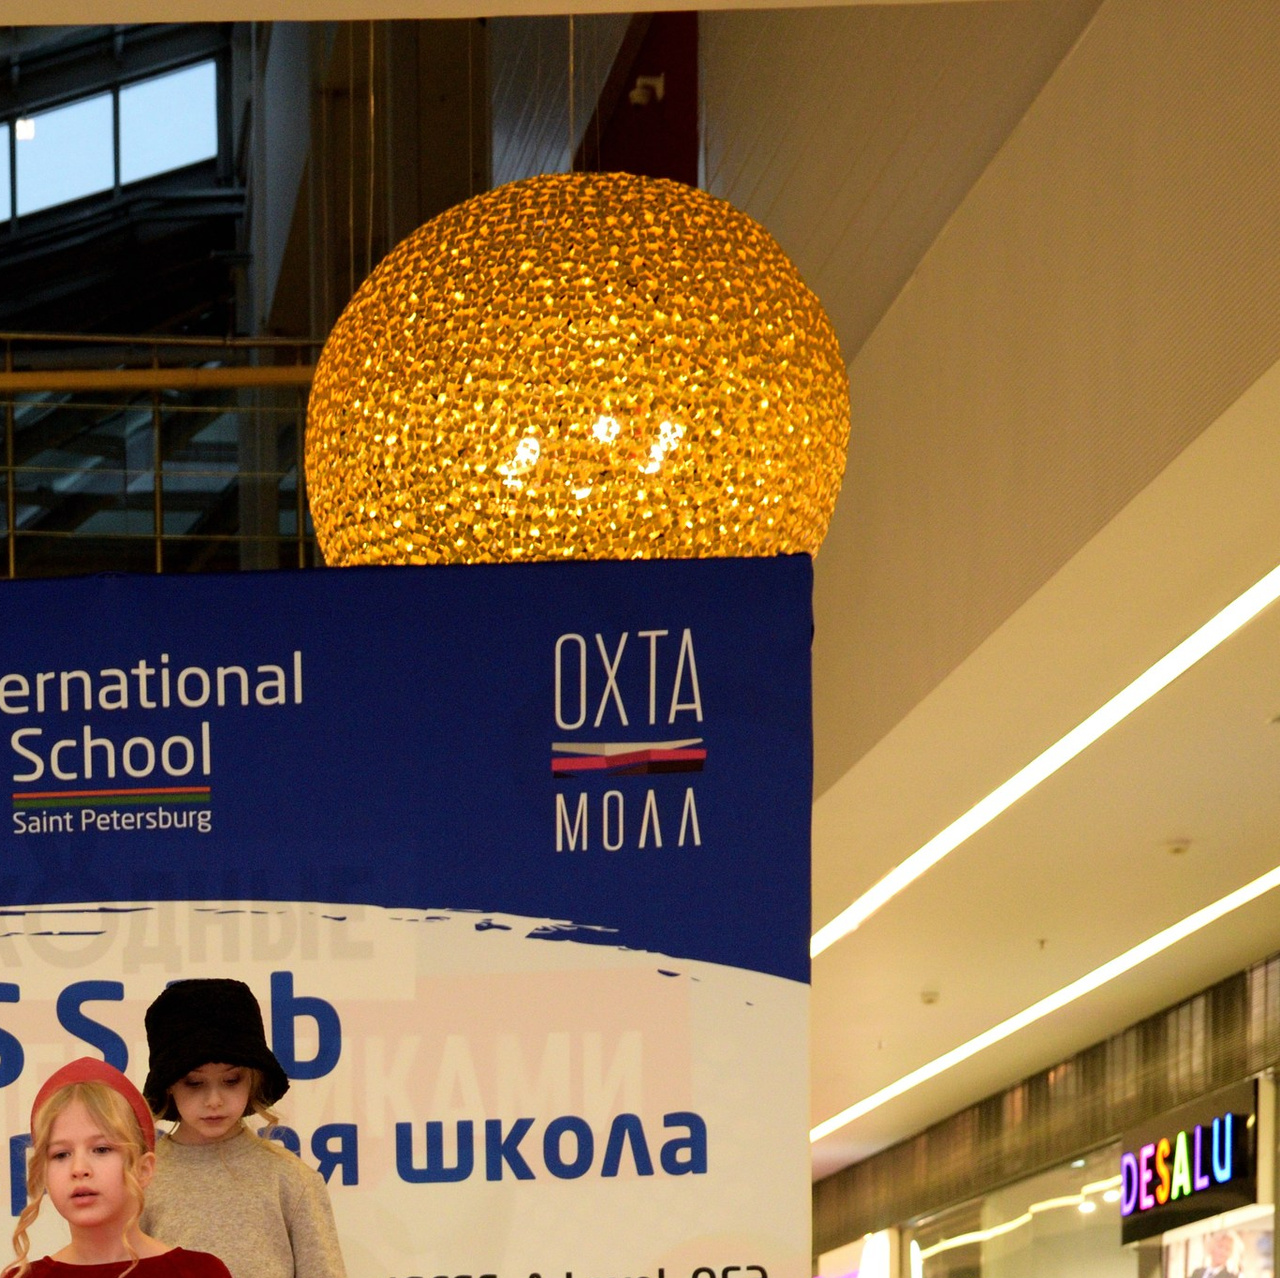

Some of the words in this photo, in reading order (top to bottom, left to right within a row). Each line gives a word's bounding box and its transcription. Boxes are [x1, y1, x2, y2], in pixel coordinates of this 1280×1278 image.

[554, 628, 704, 731] ОХТА
[11, 721, 212, 783] School
[12, 811, 74, 834] Saint
[80, 805, 213, 833] Petersburg
[395, 1111, 708, 1185] школа
[1121, 1112, 1233, 1217] DESALU
